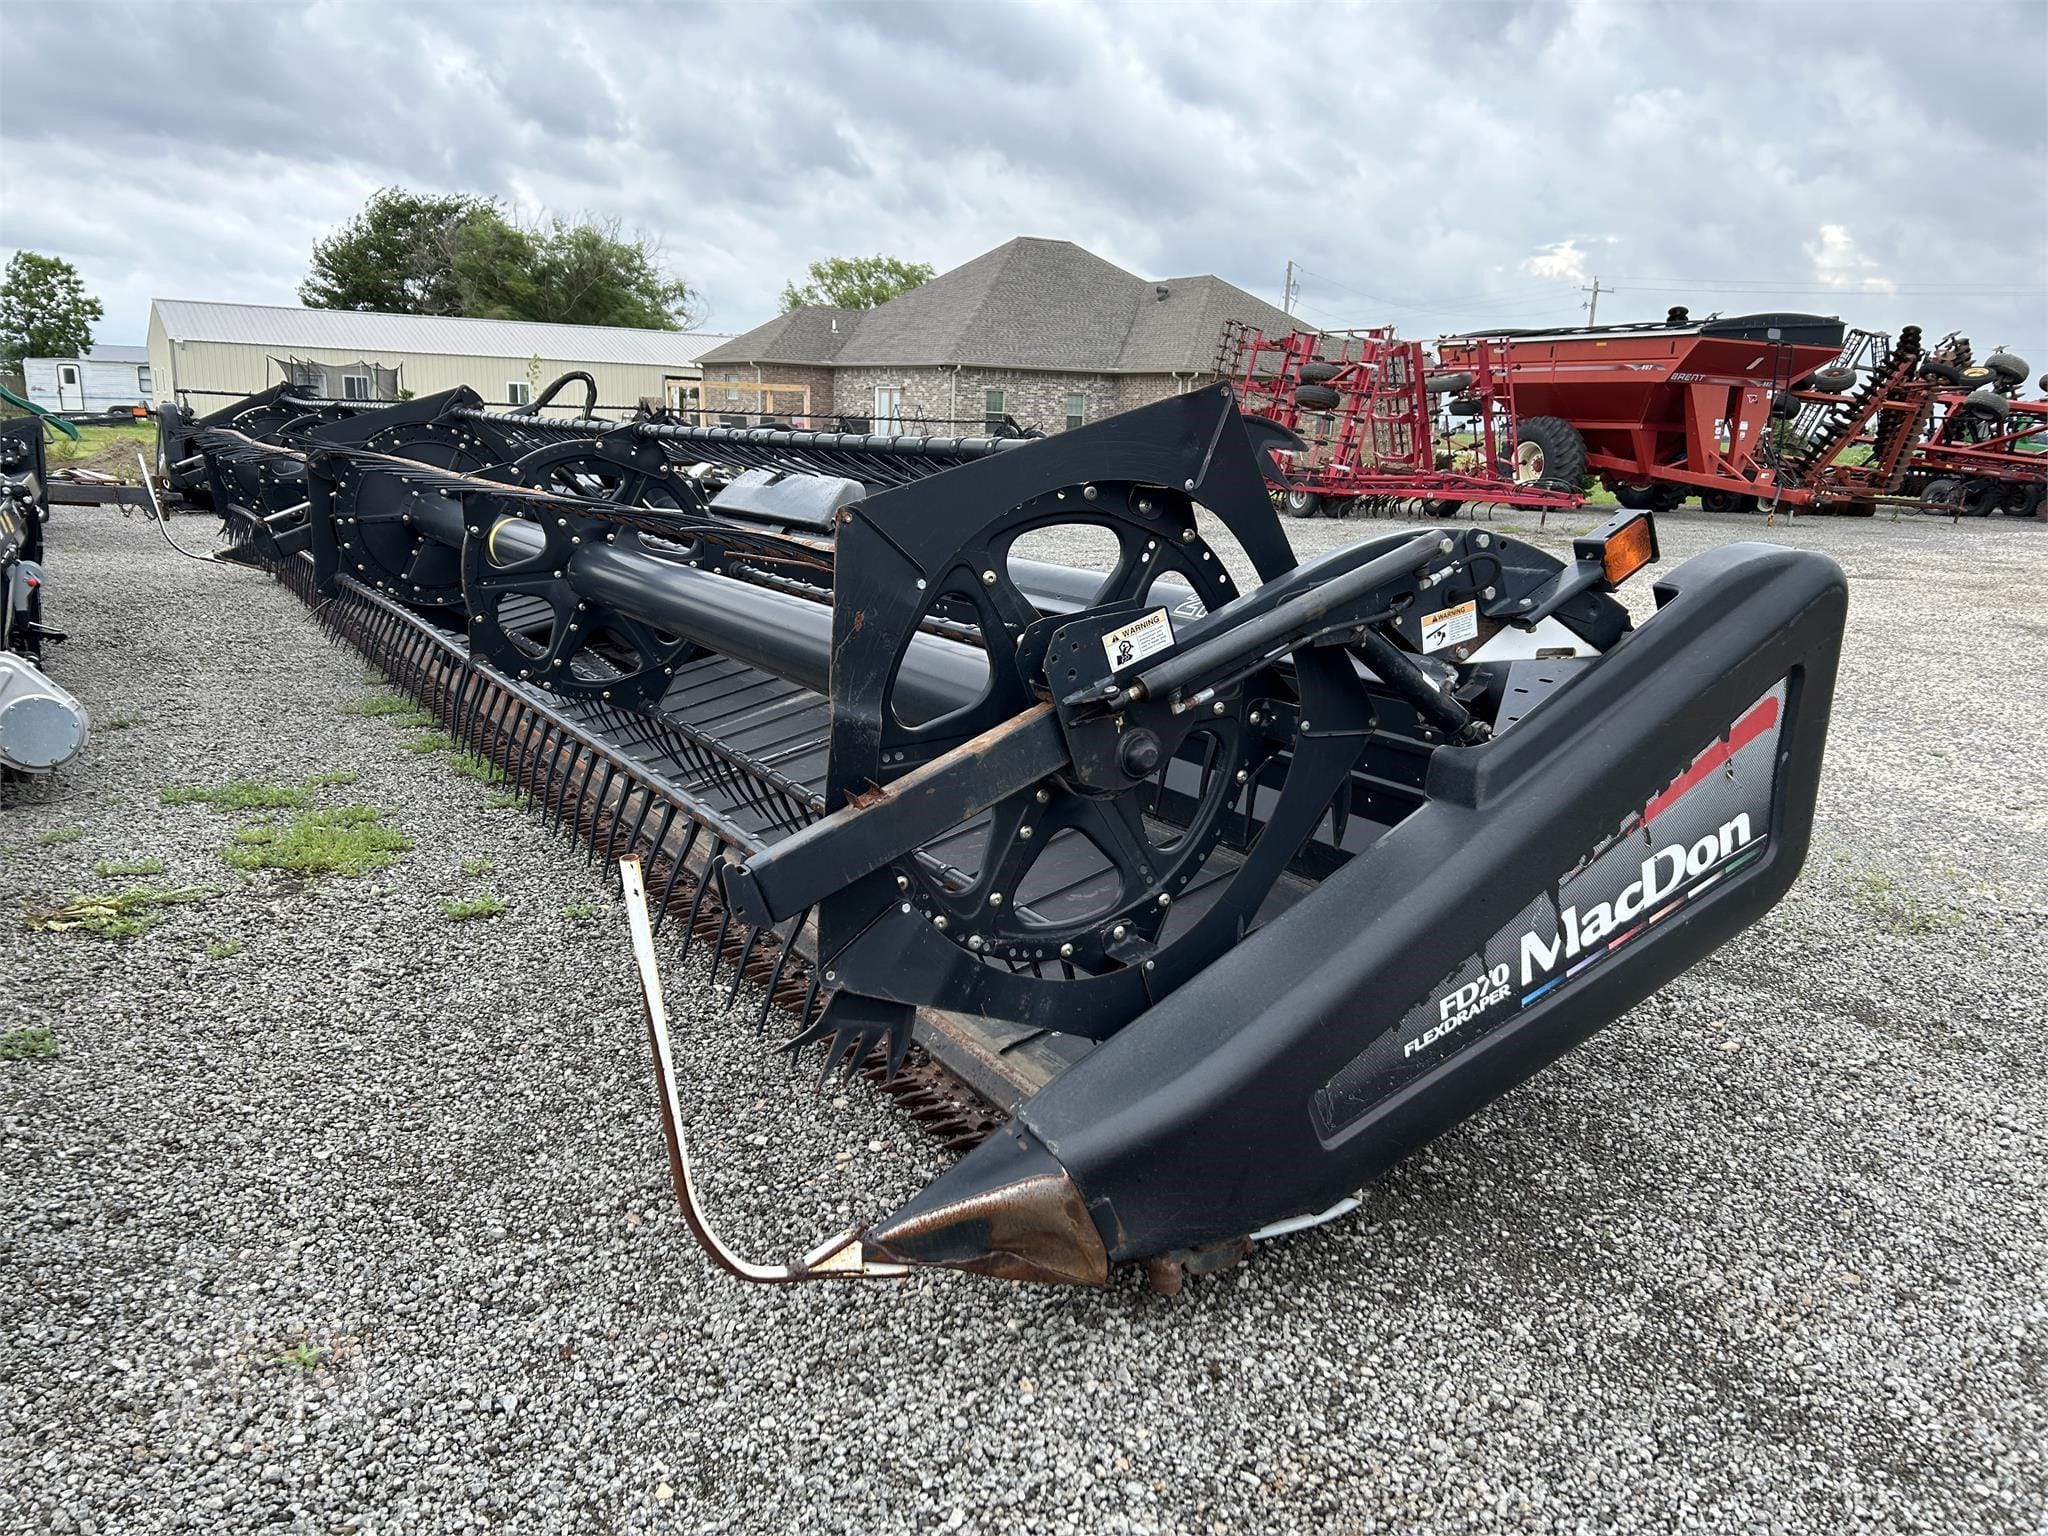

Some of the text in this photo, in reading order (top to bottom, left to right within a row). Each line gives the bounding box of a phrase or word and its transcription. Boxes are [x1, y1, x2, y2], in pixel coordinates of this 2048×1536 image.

[1670, 372, 1706, 382] BRENT
[1121, 615, 1160, 637] WARNING
[1438, 606, 1466, 621] WARNING
[1520, 812, 1750, 986] MacDon
[1439, 962, 1510, 1020] FD70
[1403, 983, 1512, 1058] FLEXDRAPER
